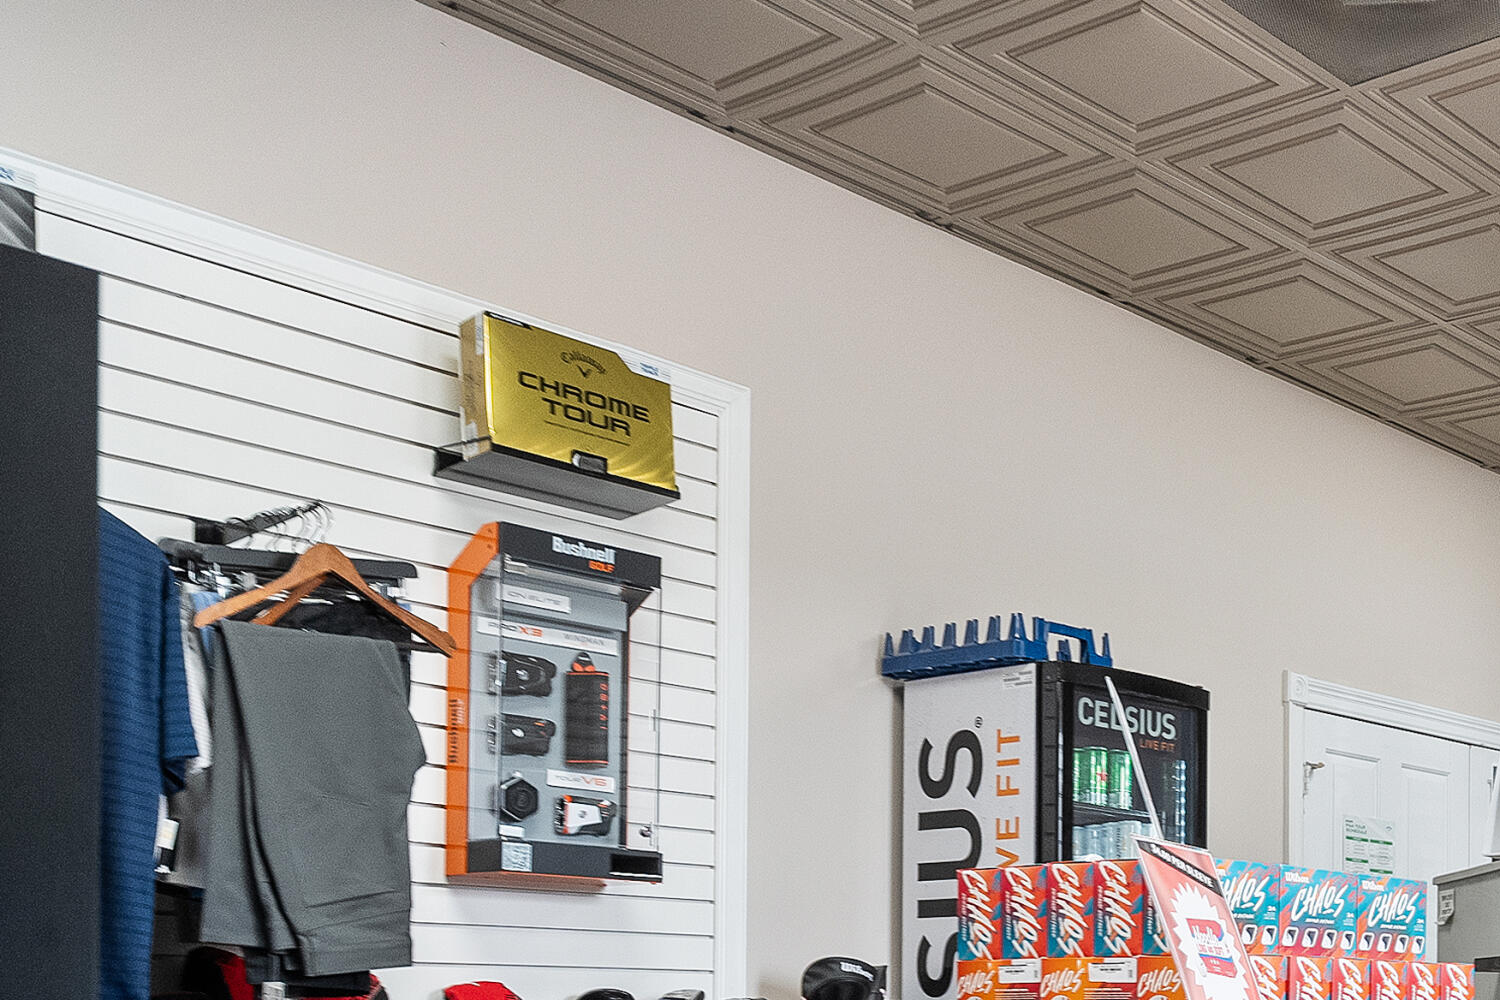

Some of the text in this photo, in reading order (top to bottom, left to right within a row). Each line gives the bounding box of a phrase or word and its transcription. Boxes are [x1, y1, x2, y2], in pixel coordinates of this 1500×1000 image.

[517, 370, 650, 423] CHROME
[542, 397, 631, 437] TOUR
[552, 536, 617, 564] Bushnell
[1077, 696, 1177, 741] CELSIUS
[996, 729, 1021, 797] FIT
[917, 728, 983, 998] SIUS
[1005, 866, 1044, 959] CHAOS
[1051, 863, 1090, 958] CHAOS
[1098, 860, 1137, 957] CHAOS
[1221, 872, 1270, 912] HAOS
[1291, 880, 1348, 922] CHAOS
[1368, 887, 1420, 927] CHAOS
[962, 869, 997, 961] CHAOS
[958, 969, 995, 999] CHAOS
[1041, 966, 1085, 998] CHAOS
[1137, 966, 1183, 998] CHAOS
